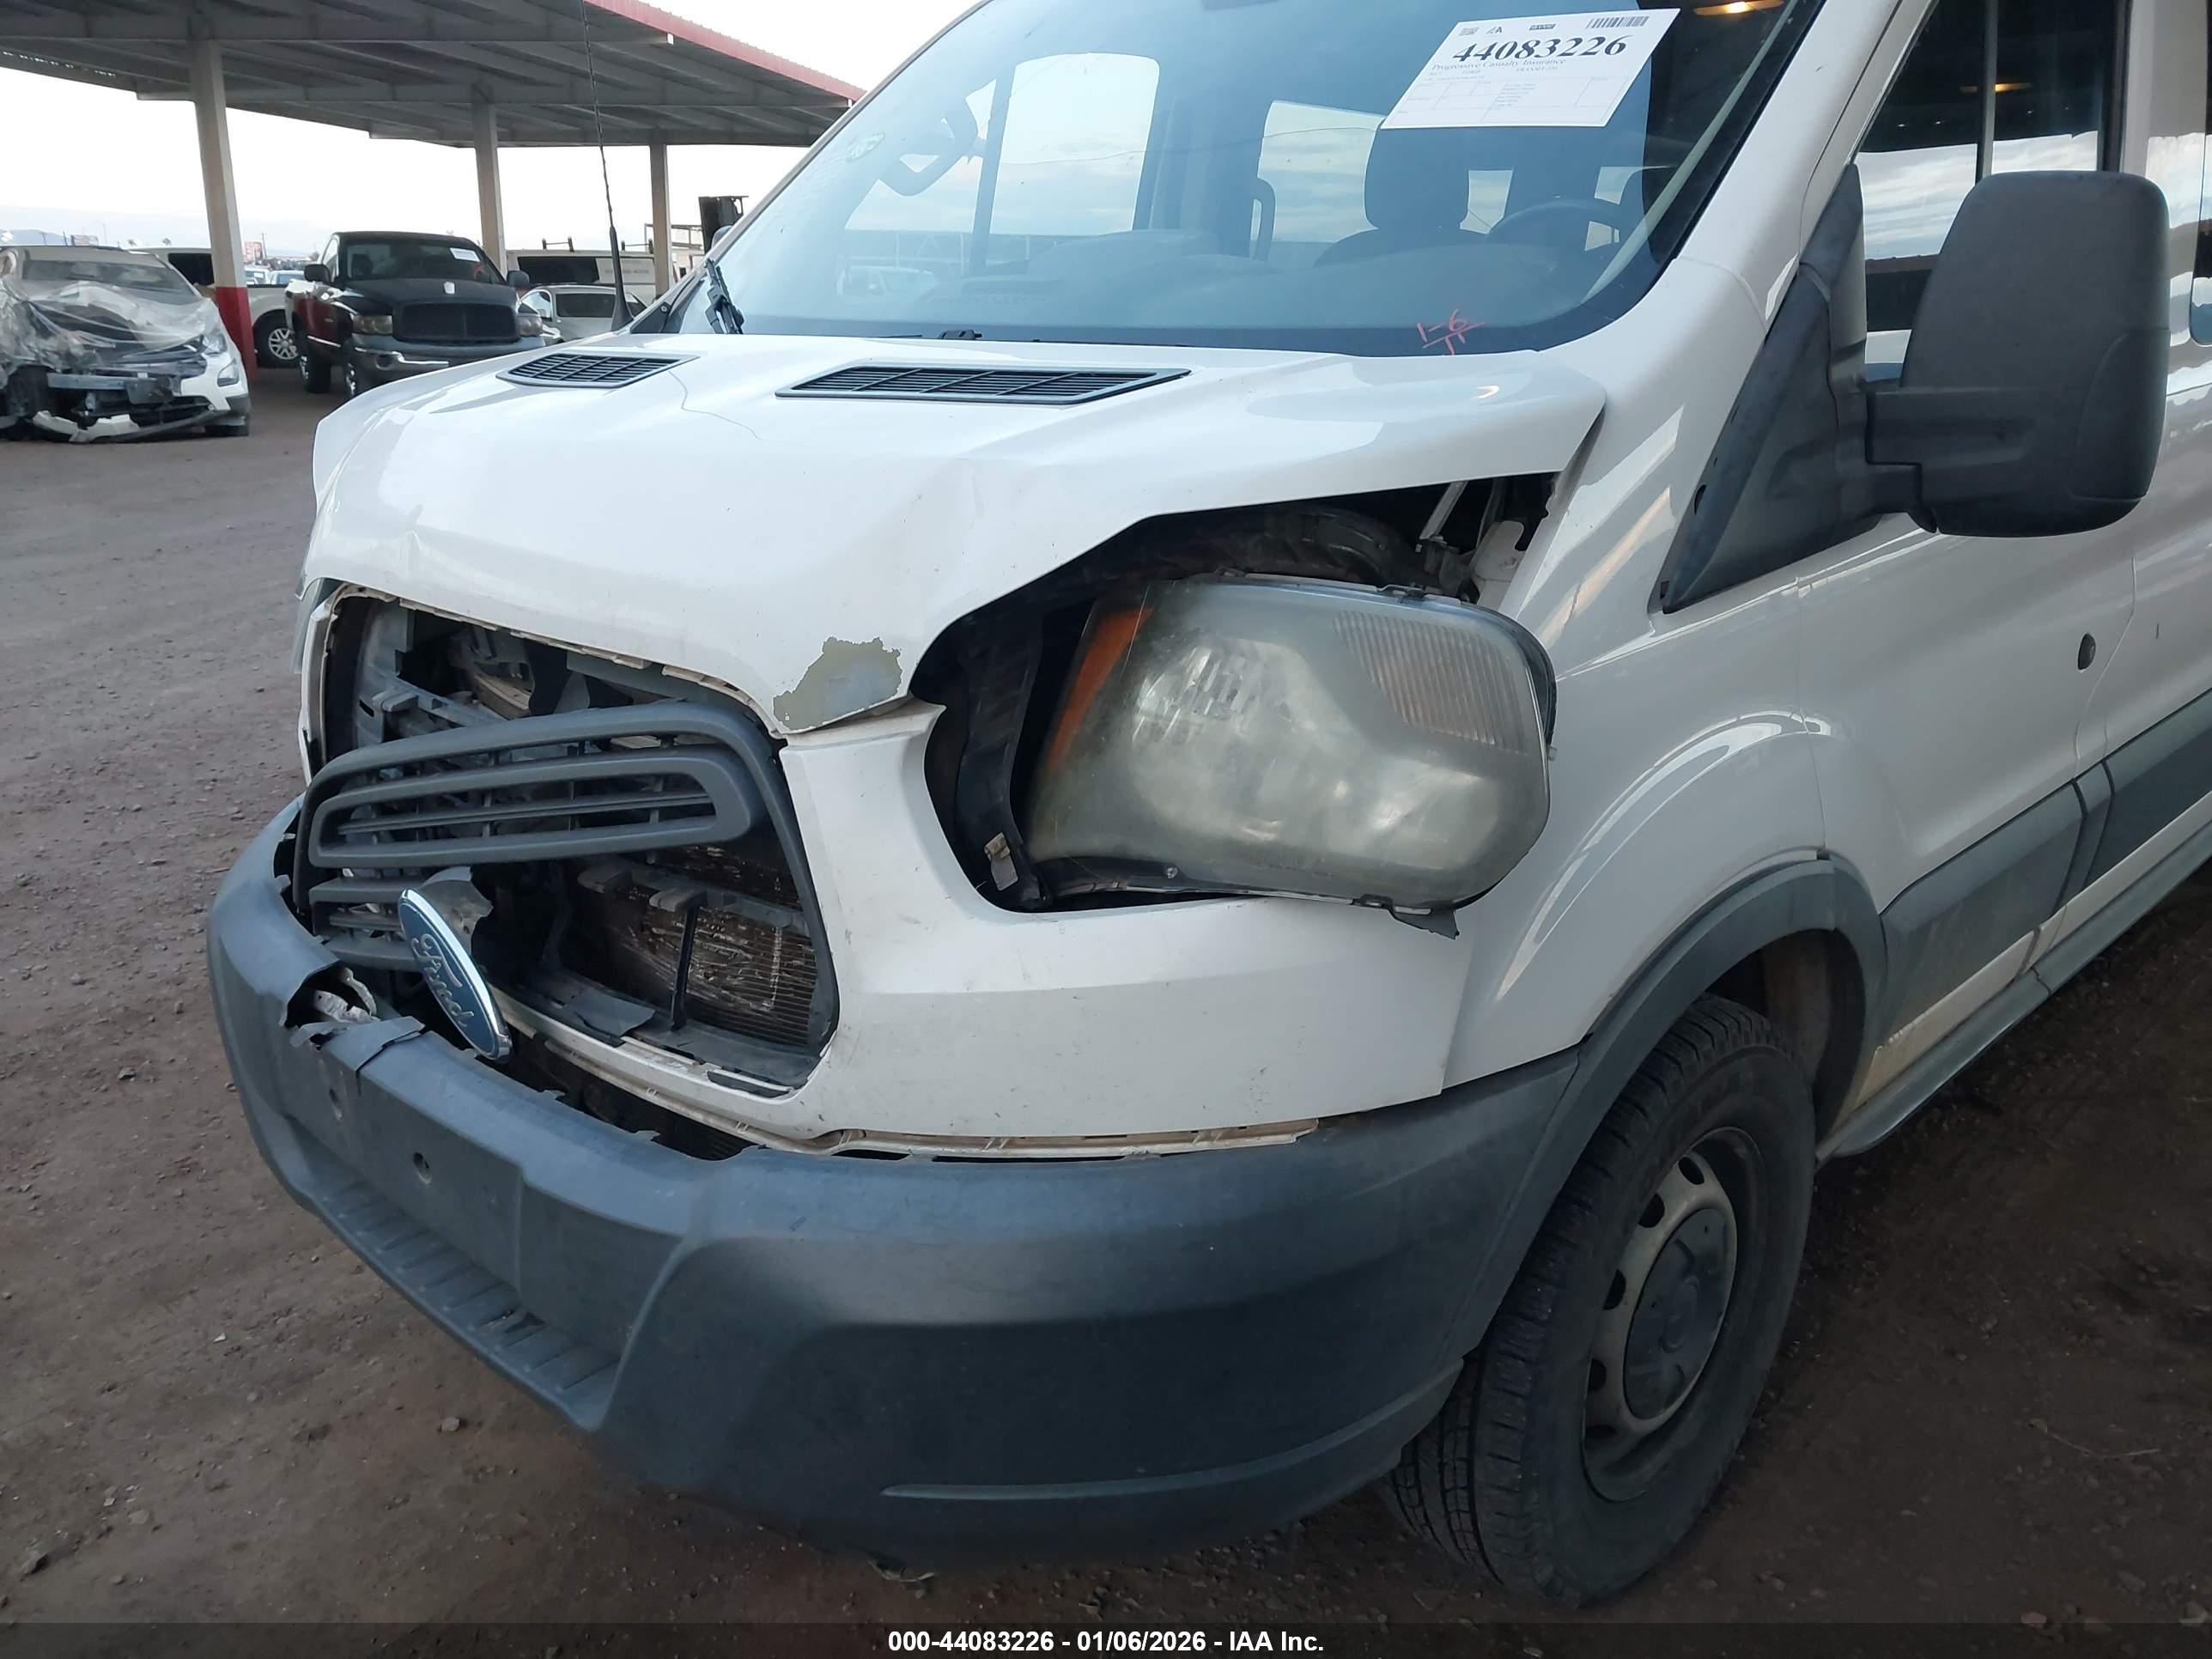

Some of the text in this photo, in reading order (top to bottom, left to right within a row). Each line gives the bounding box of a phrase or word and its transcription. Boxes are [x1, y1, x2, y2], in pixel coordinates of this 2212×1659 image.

[1453, 35, 1632, 62] 44083226
[1431, 58, 1566, 71] Progressive Casualty Insurance
[410, 933, 475, 1028] Ford
